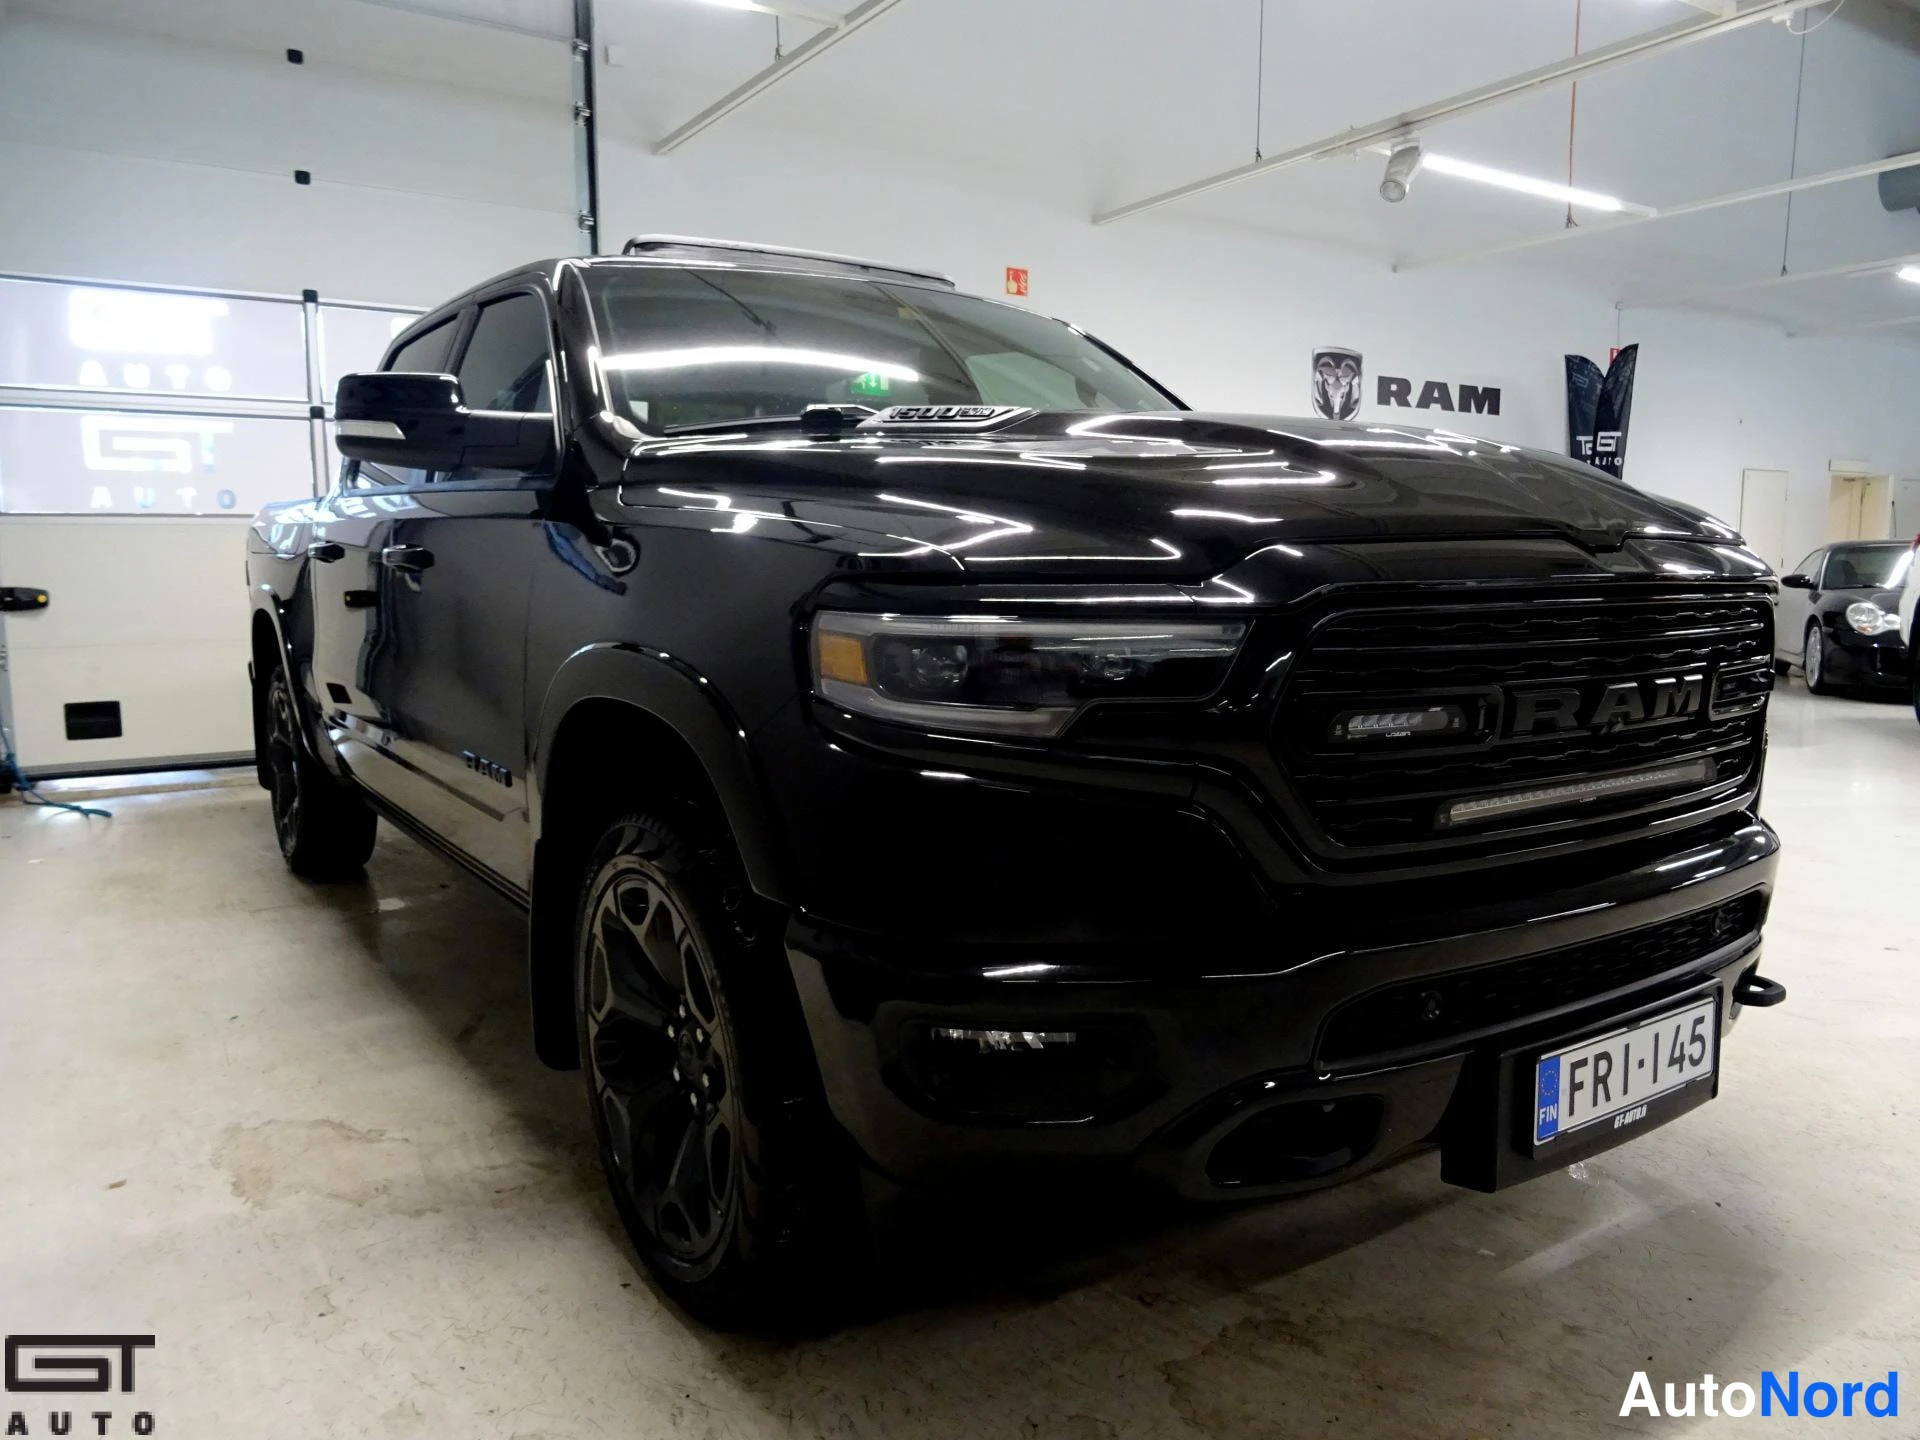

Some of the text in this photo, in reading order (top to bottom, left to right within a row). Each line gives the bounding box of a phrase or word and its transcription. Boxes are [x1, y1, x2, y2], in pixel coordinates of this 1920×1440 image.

[1377, 375, 1501, 416] RAM
[89, 486, 237, 509] AUTO
[1513, 674, 1704, 733] RAM
[463, 751, 513, 788] RAM
[1568, 1015, 1706, 1118] FRI-145
[1539, 1103, 1557, 1125] FIN
